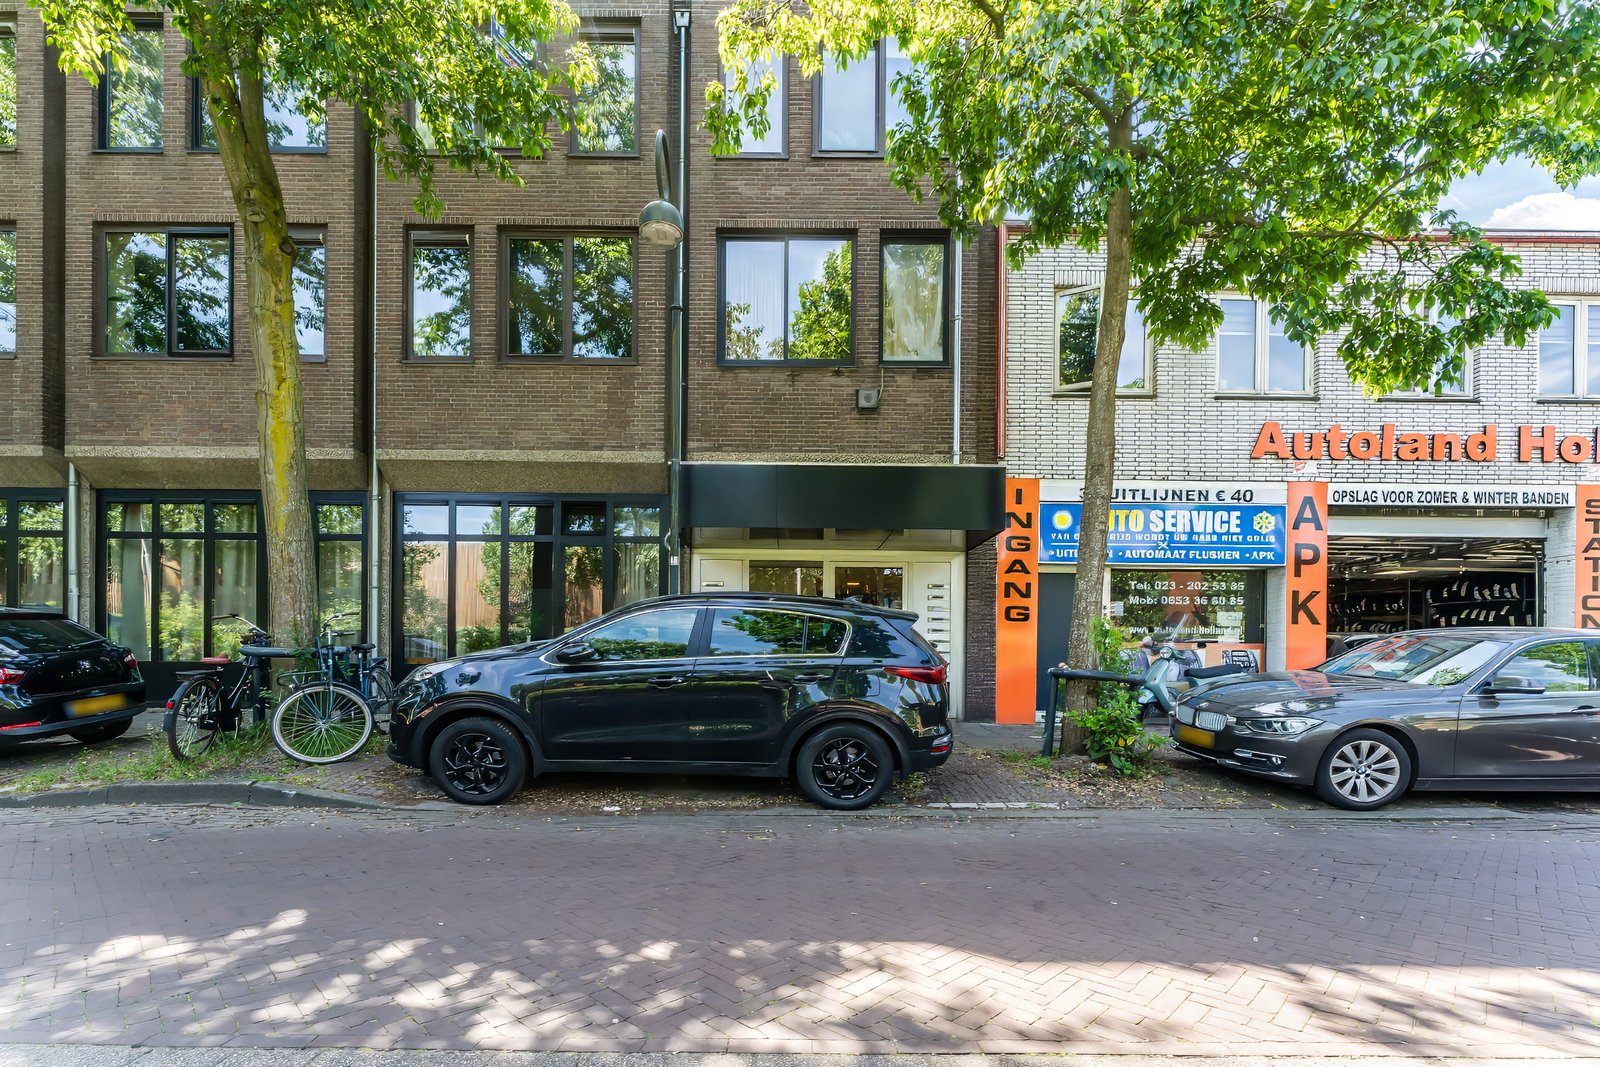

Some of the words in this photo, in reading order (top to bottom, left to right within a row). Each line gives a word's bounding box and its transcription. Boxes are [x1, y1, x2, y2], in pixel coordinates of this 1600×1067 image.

[1250, 421, 1497, 462] Autoland
[1215, 490, 1226, 502] €
[1230, 489, 1254, 503] 40
[1332, 490, 1378, 503] OPSLAG
[1381, 490, 1414, 504] VOOR
[1417, 490, 1457, 504] ZOMER
[1462, 491, 1470, 503] &
[1473, 491, 1519, 505] WINTER
[1522, 491, 1570, 505] BANDEN
[1149, 509, 1241, 533] SERVICE
[1004, 488, 1032, 622] INGANG
[1124, 549, 1186, 559] AUTOMAAT
[1189, 550, 1240, 560] FLUSHEN
[1251, 551, 1275, 560] APK
[1291, 495, 1324, 625] APK
[1154, 581, 1176, 590] 023
